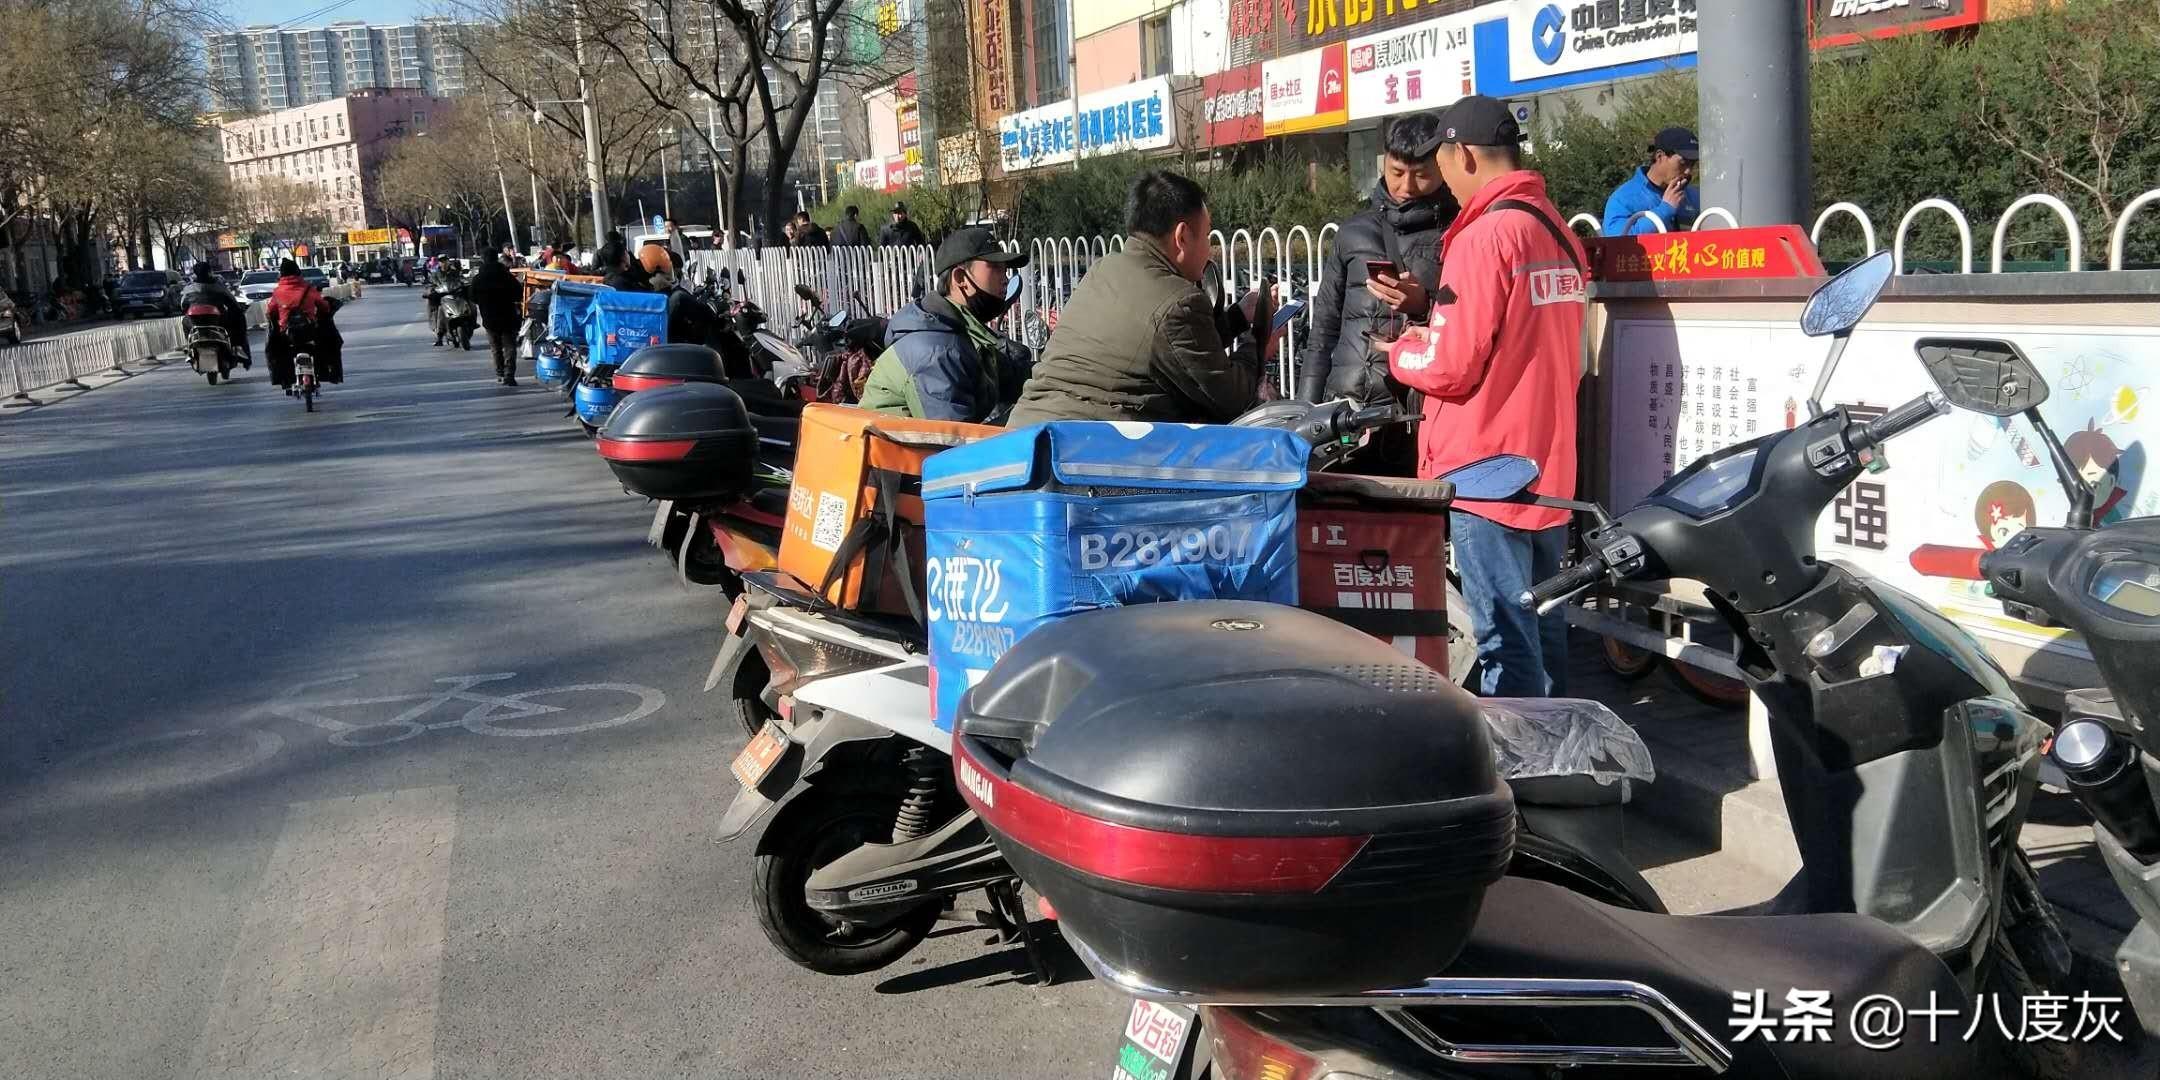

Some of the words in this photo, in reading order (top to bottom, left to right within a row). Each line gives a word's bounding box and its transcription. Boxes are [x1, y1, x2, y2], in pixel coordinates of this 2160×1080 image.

[1573, 34, 1604, 53] China
[1606, 20, 1677, 47] Construction
[1616, 237, 1766, 275] 社会主义核心价值观
[1728, 366, 1740, 446] 社会主义
[1079, 520, 1253, 571] B281907
